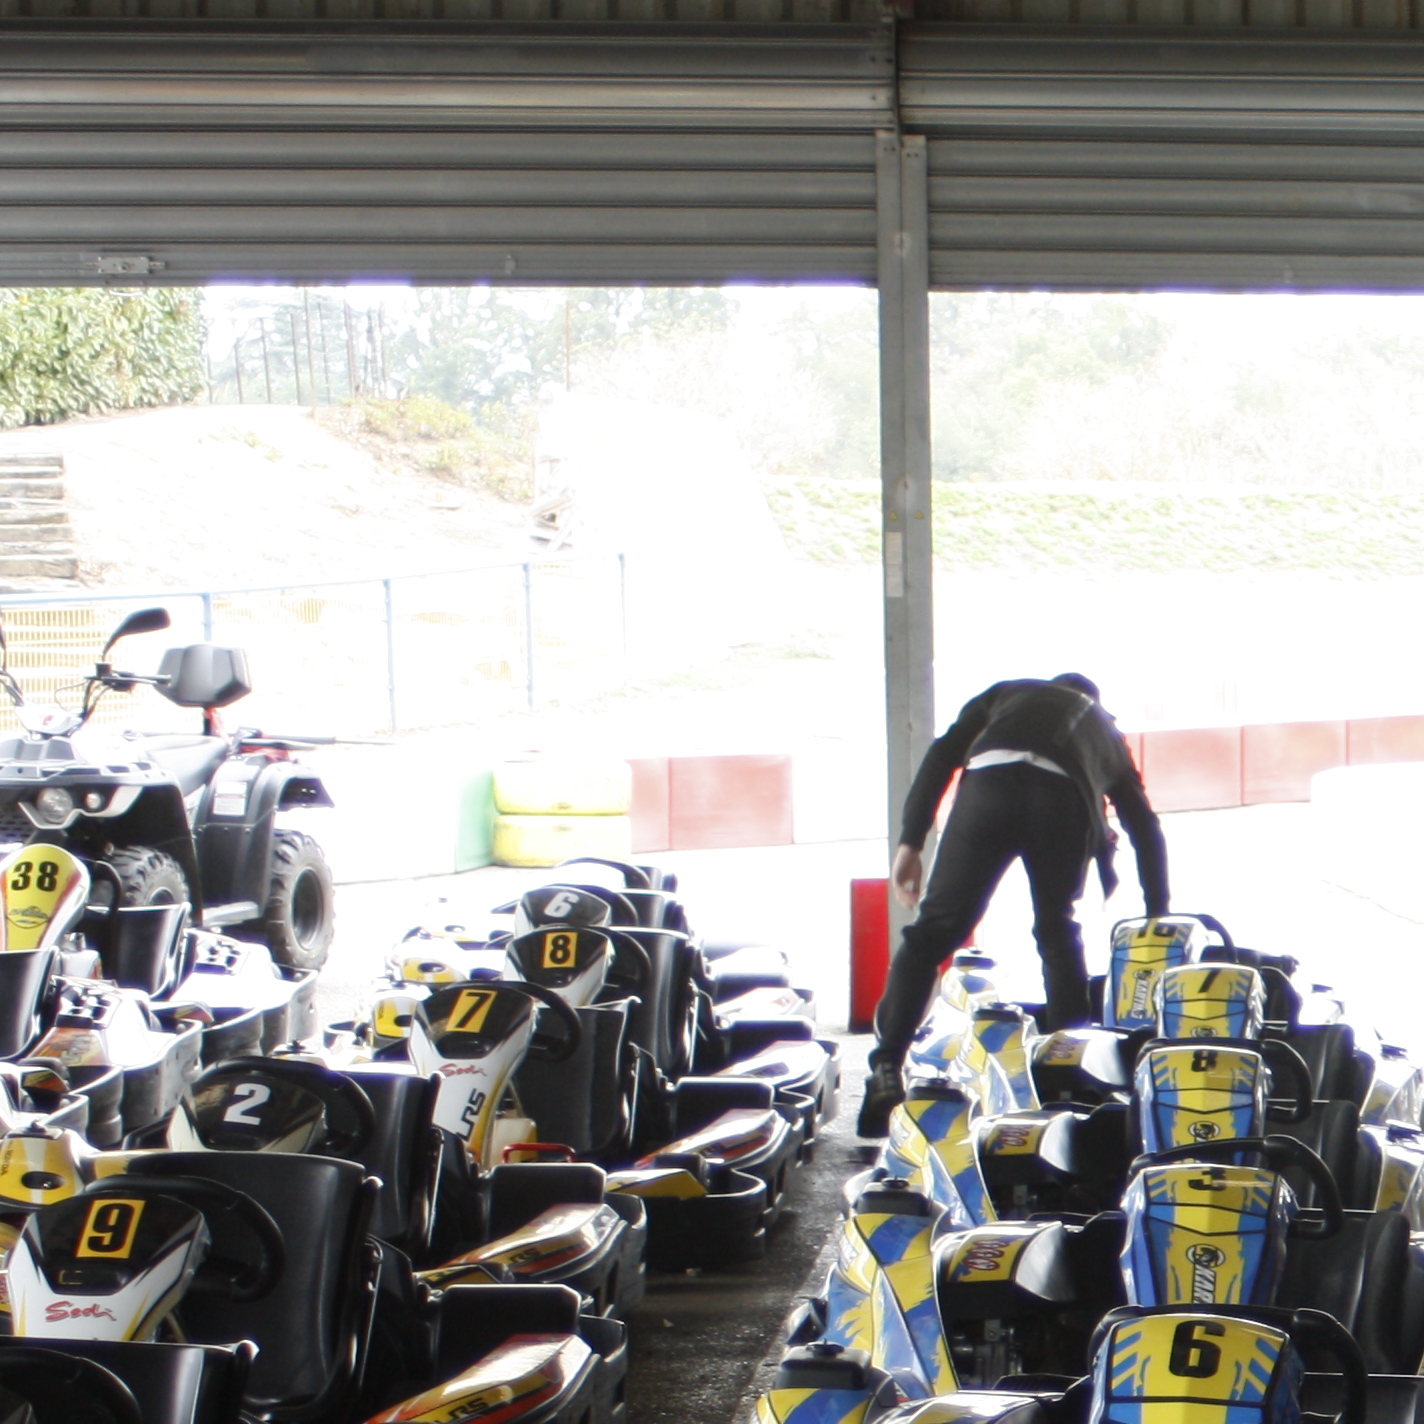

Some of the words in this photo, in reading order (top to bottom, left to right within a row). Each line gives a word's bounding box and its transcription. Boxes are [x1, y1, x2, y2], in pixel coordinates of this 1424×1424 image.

[11, 861, 59, 892] 38
[543, 892, 581, 918] 6
[549, 934, 571, 965] 8
[456, 991, 492, 1029] 7
[438, 1062, 487, 1078] Sodi
[223, 1083, 271, 1126] 2
[87, 1203, 138, 1252] 9
[45, 1299, 117, 1323] Sodi
[1169, 1319, 1226, 1379] 6
